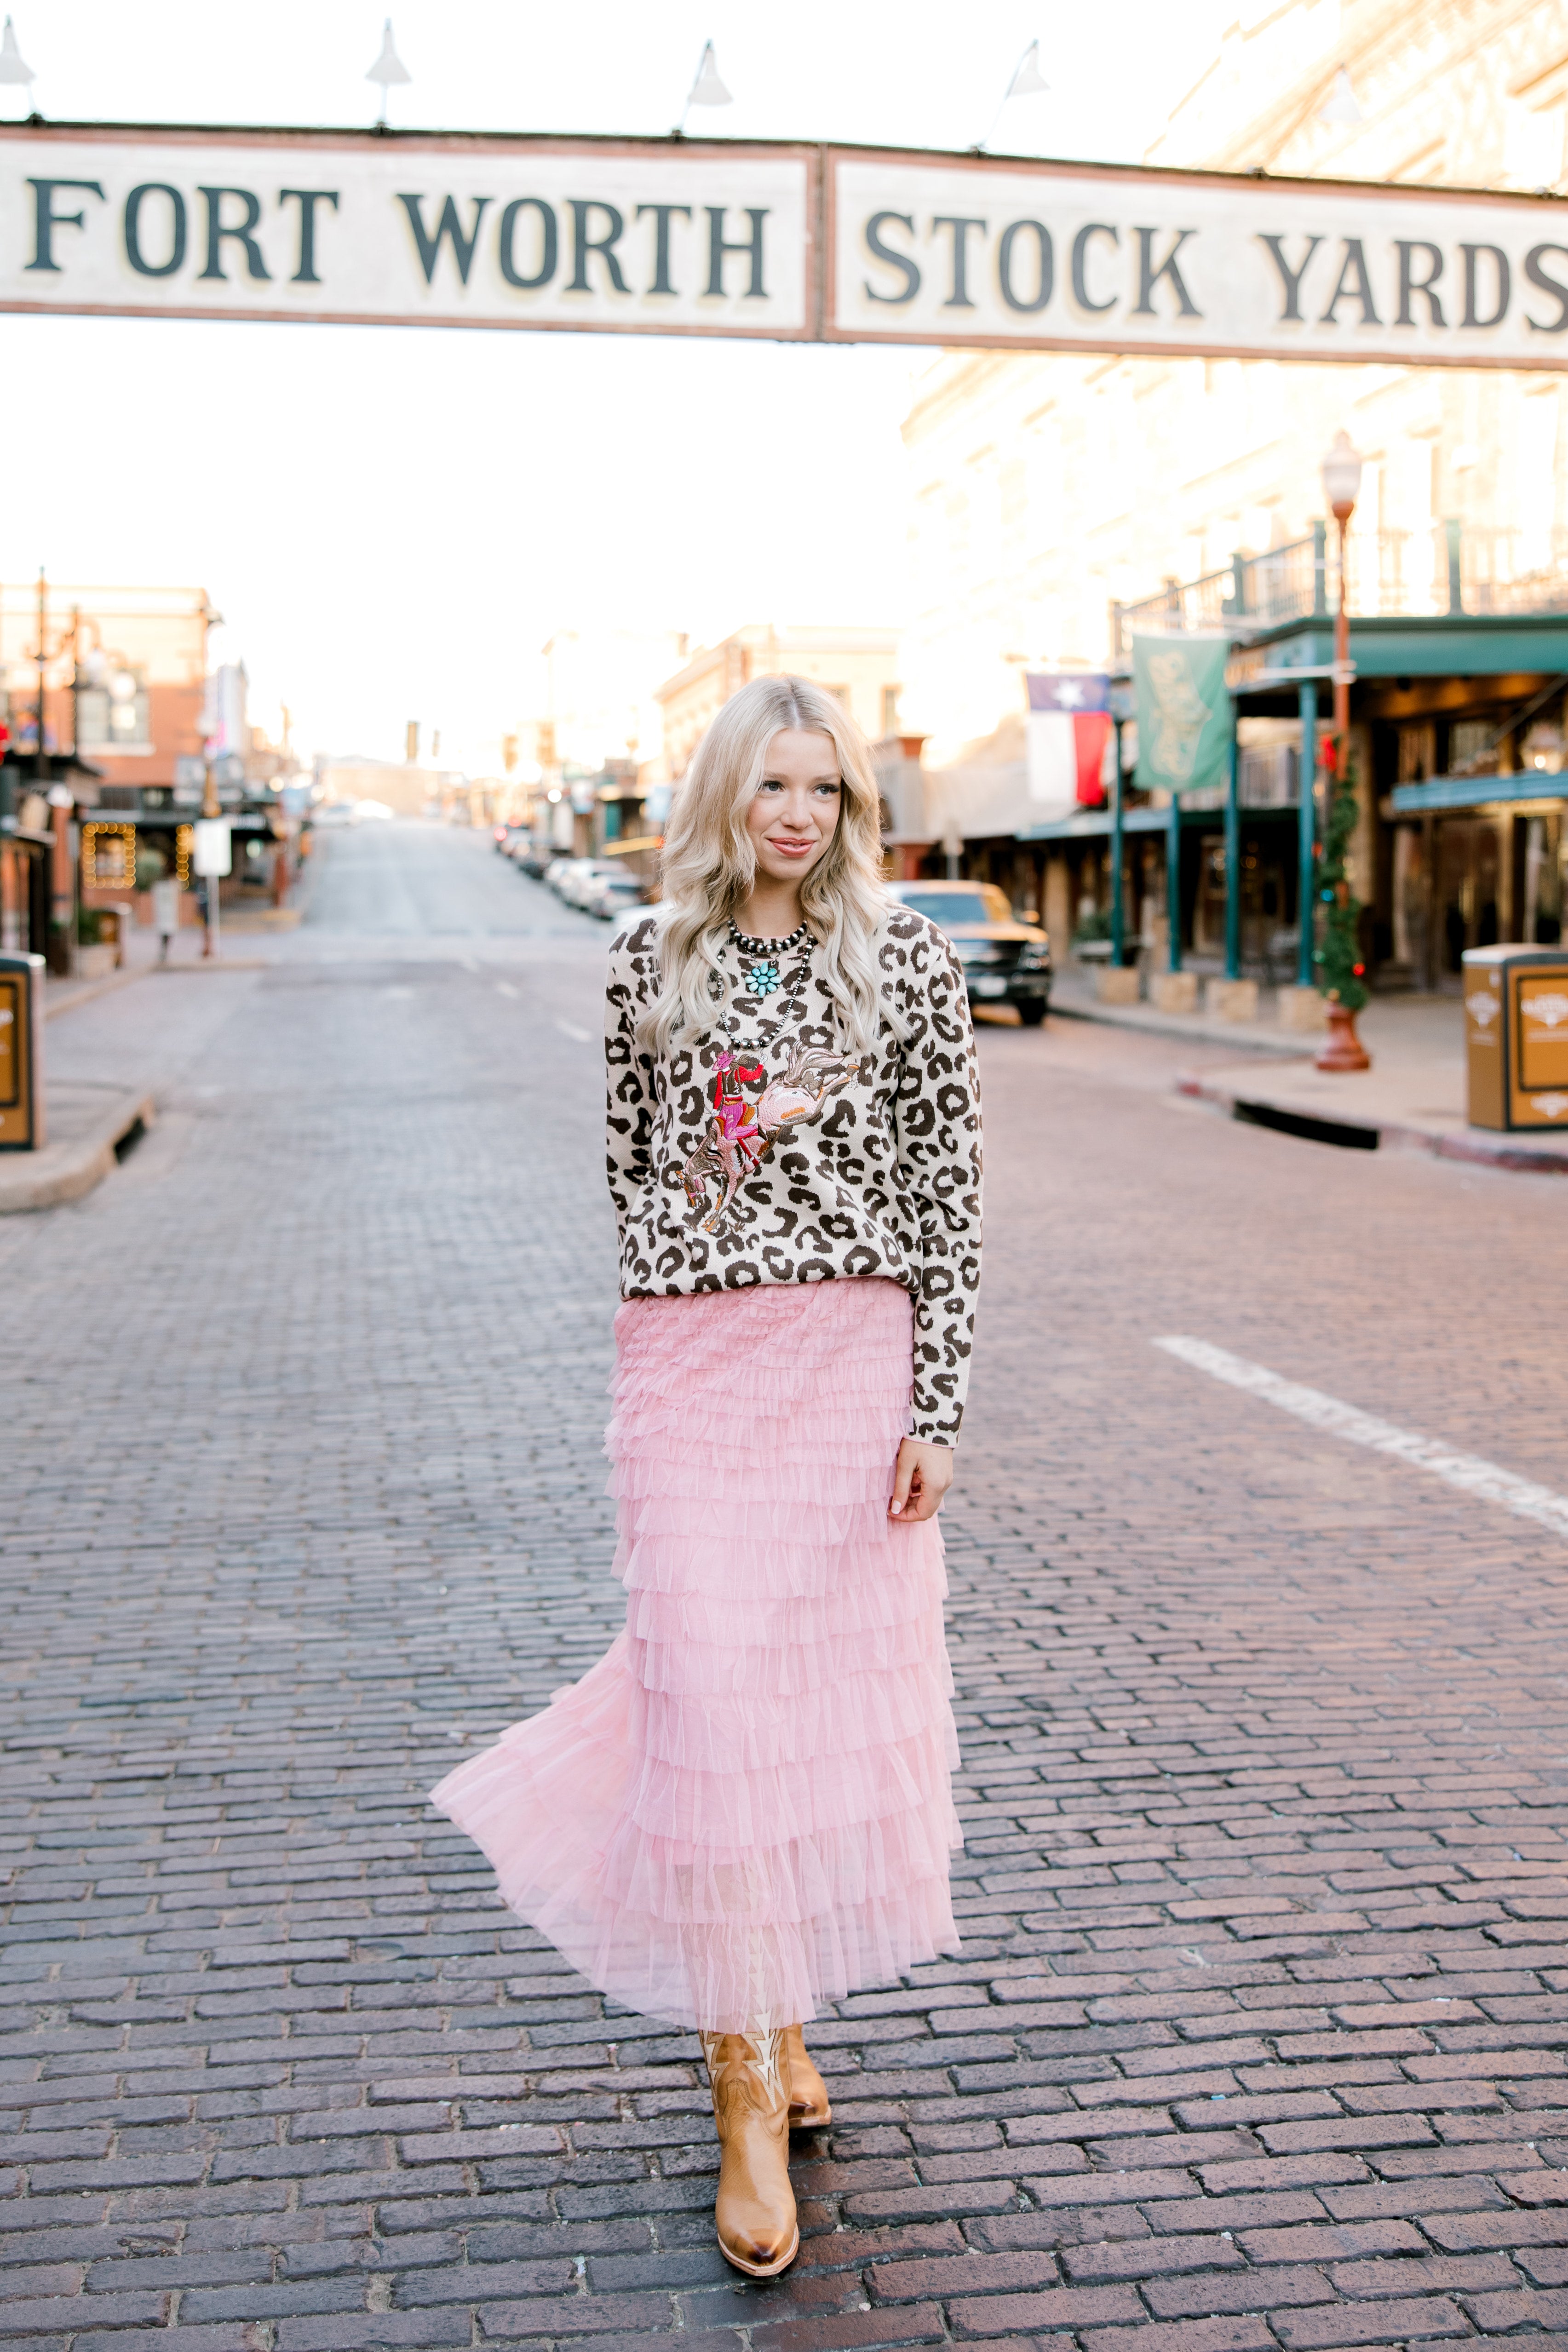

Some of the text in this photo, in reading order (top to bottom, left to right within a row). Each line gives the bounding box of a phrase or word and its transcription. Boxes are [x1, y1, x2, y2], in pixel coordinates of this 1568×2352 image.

[23, 177, 1568, 333] FORT WORTH STOCK YARDS
